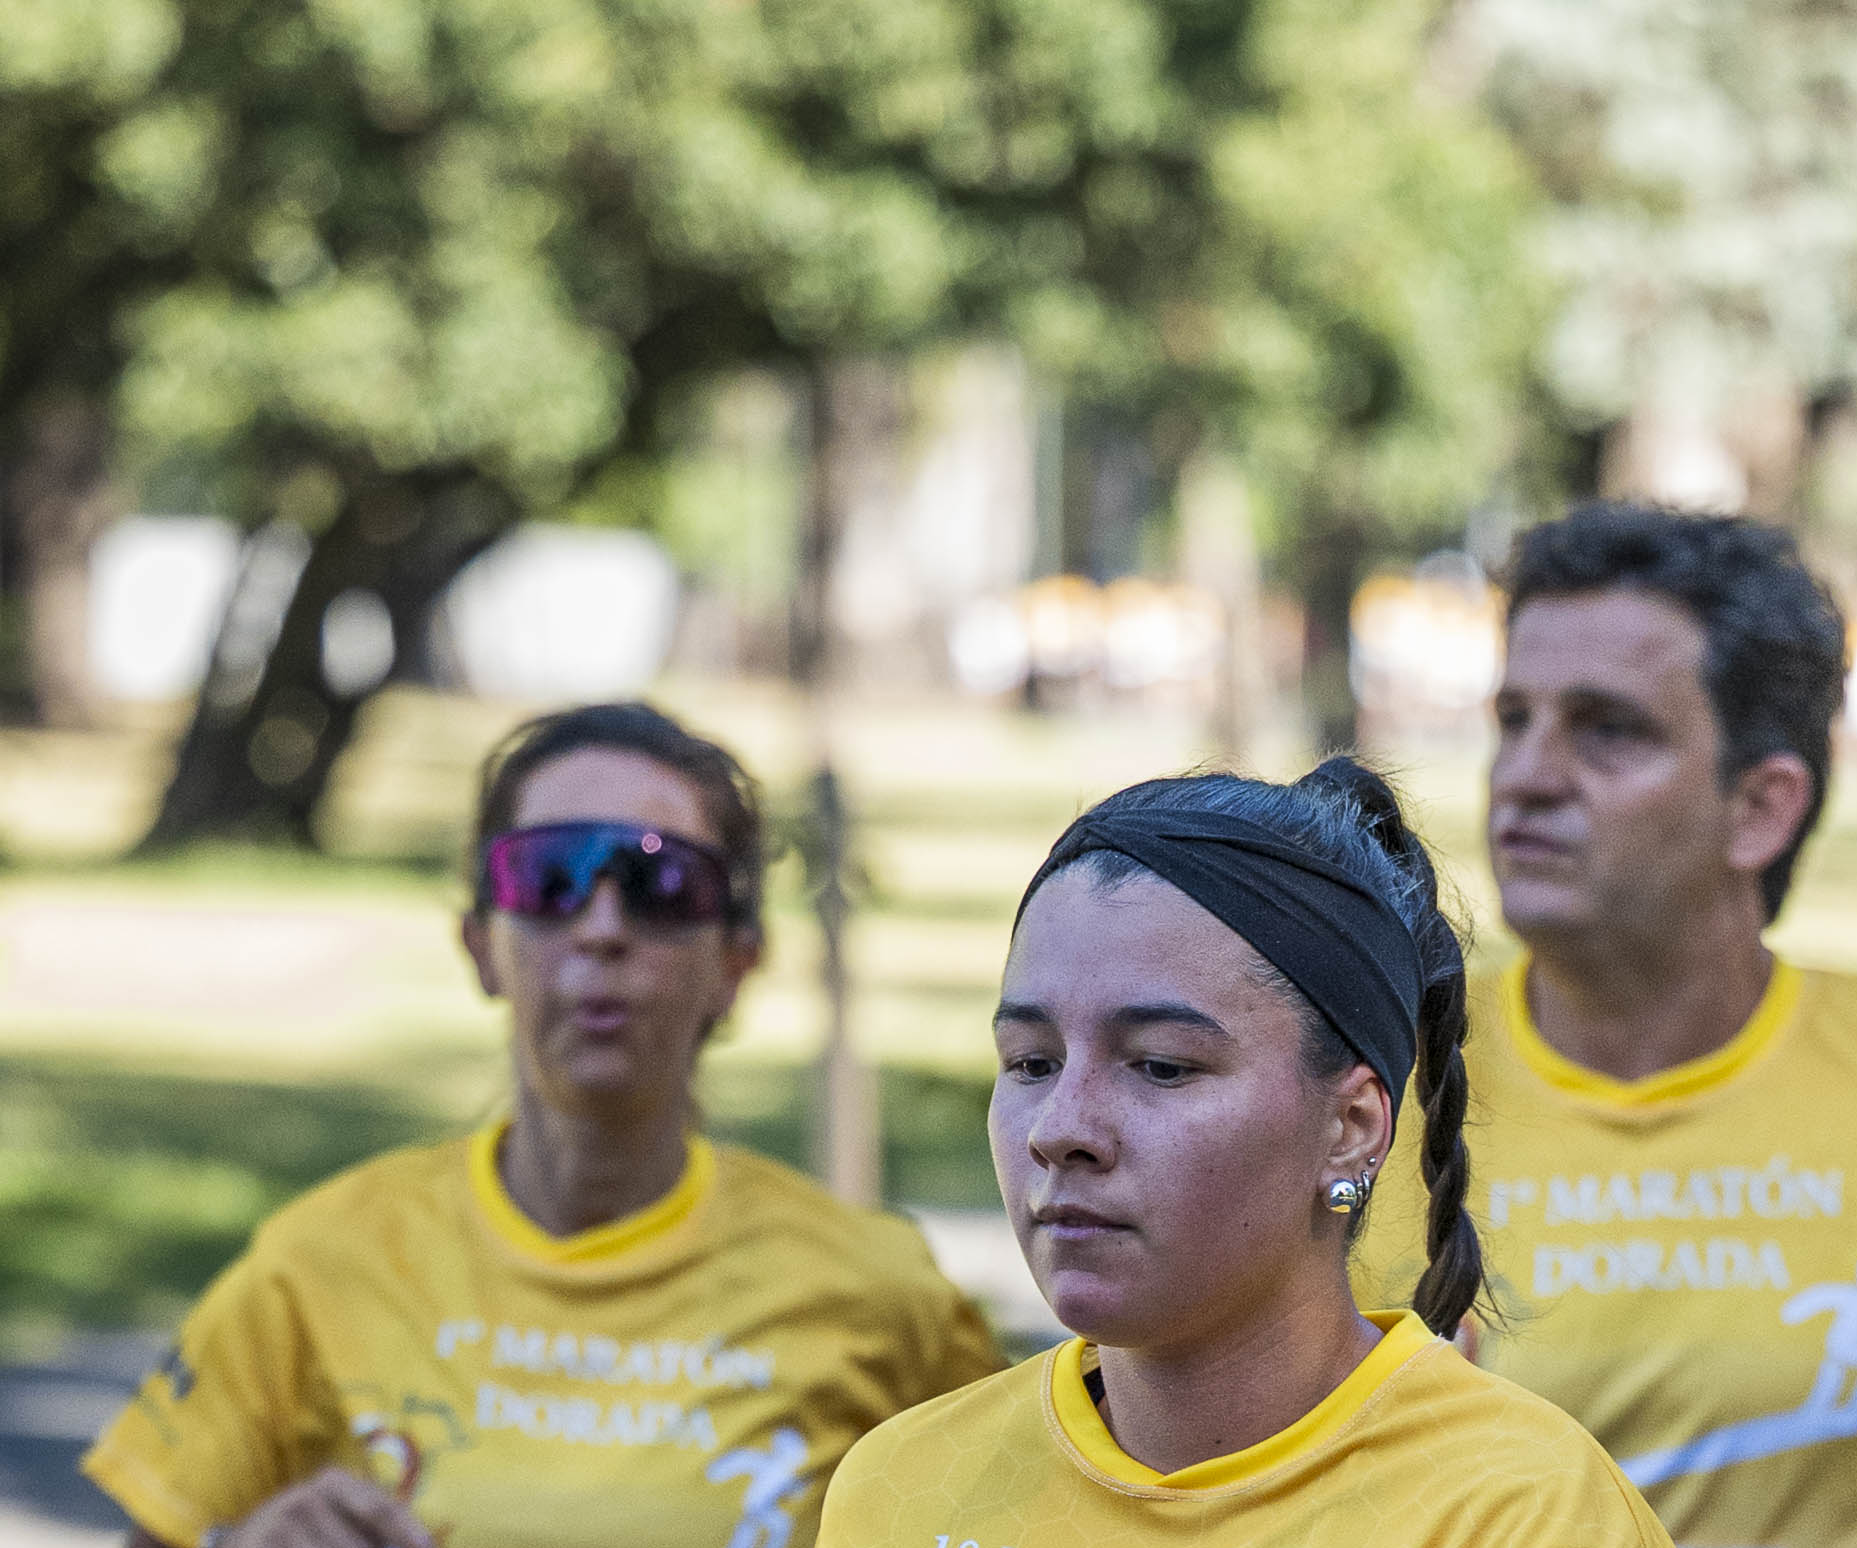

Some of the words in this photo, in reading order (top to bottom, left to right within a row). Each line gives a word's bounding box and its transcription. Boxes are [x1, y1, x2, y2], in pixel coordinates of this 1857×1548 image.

[1545, 1153, 1845, 1226] MARATÓN
[1533, 1238, 1791, 1298] DORADA
[475, 1382, 718, 1452] DORADA
